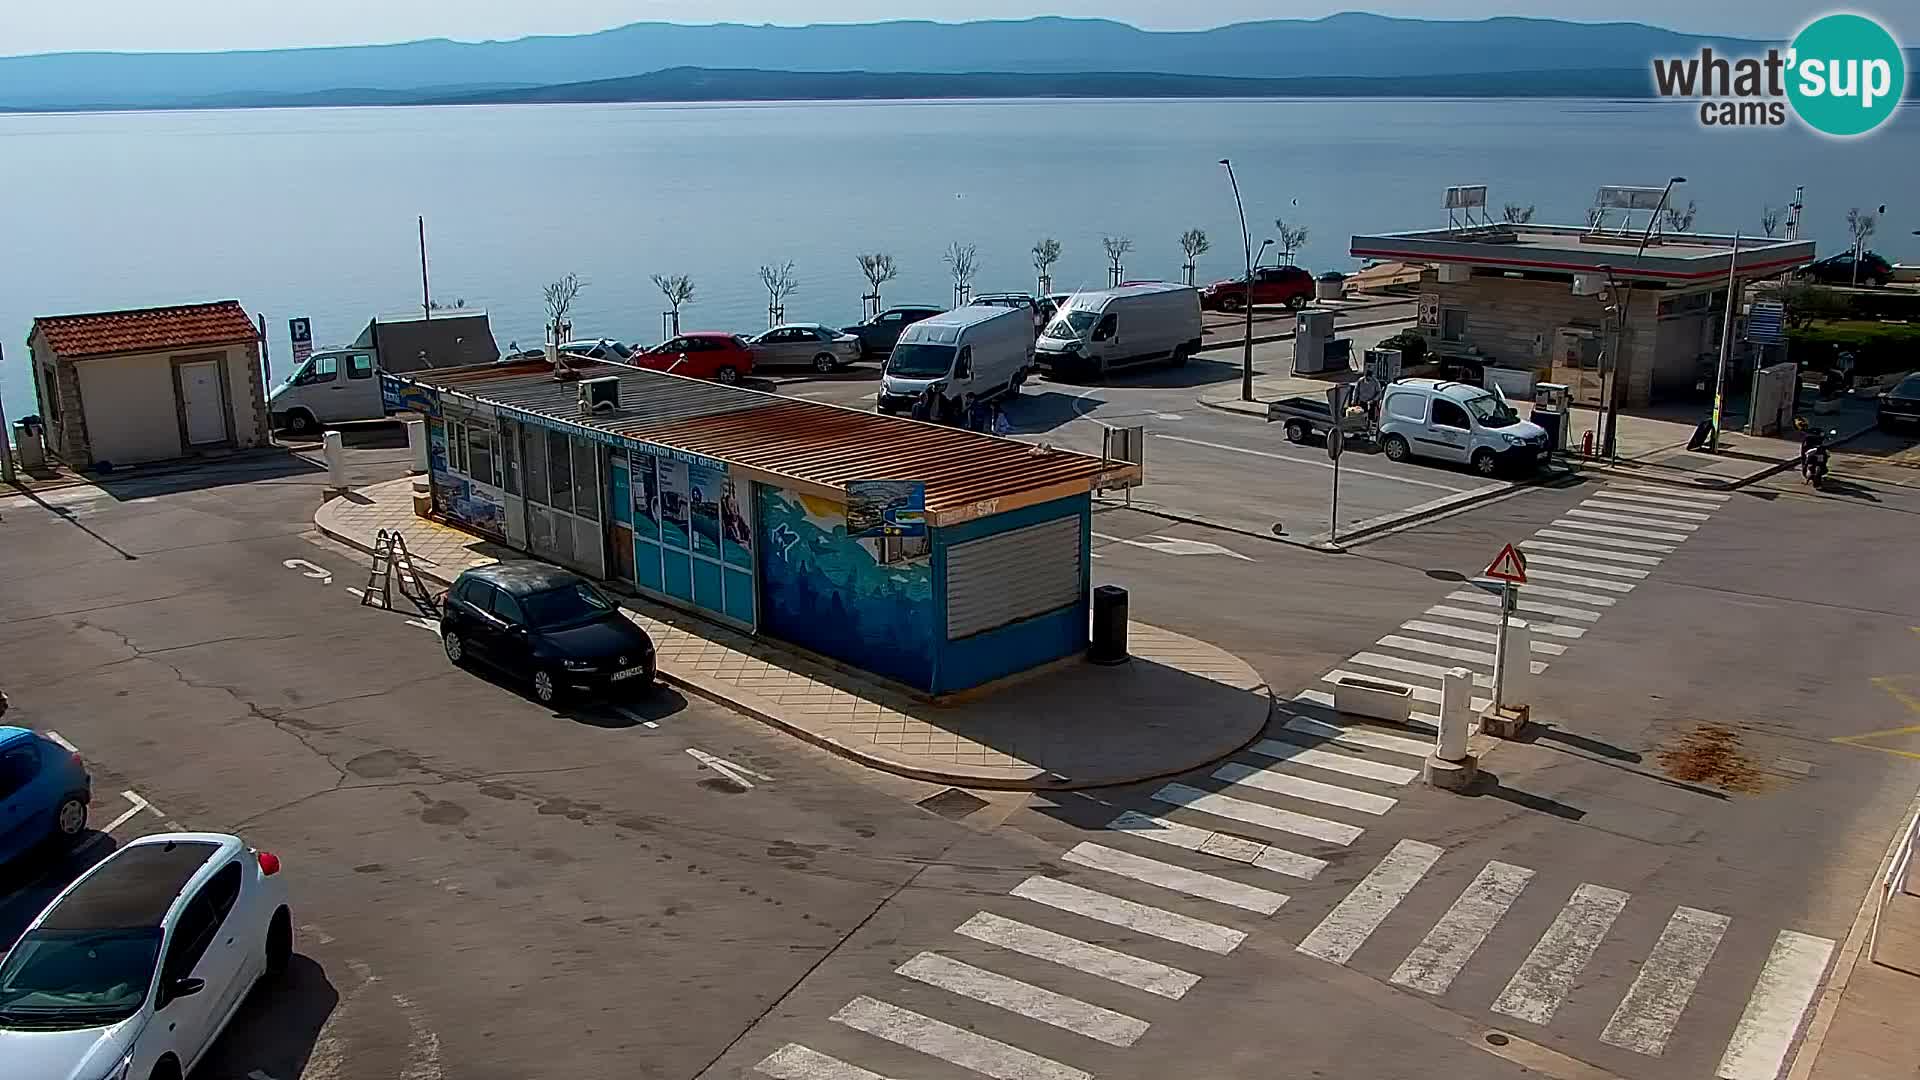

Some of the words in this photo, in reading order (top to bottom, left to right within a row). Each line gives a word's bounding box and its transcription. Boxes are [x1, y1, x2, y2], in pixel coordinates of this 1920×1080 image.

[295, 321, 306, 339] P
[584, 430, 614, 444] POSTAJA
[624, 439, 638, 449] BUS
[639, 442, 670, 457] STATION
[672, 451, 697, 464] TICKET
[698, 457, 725, 471] OFFICE
